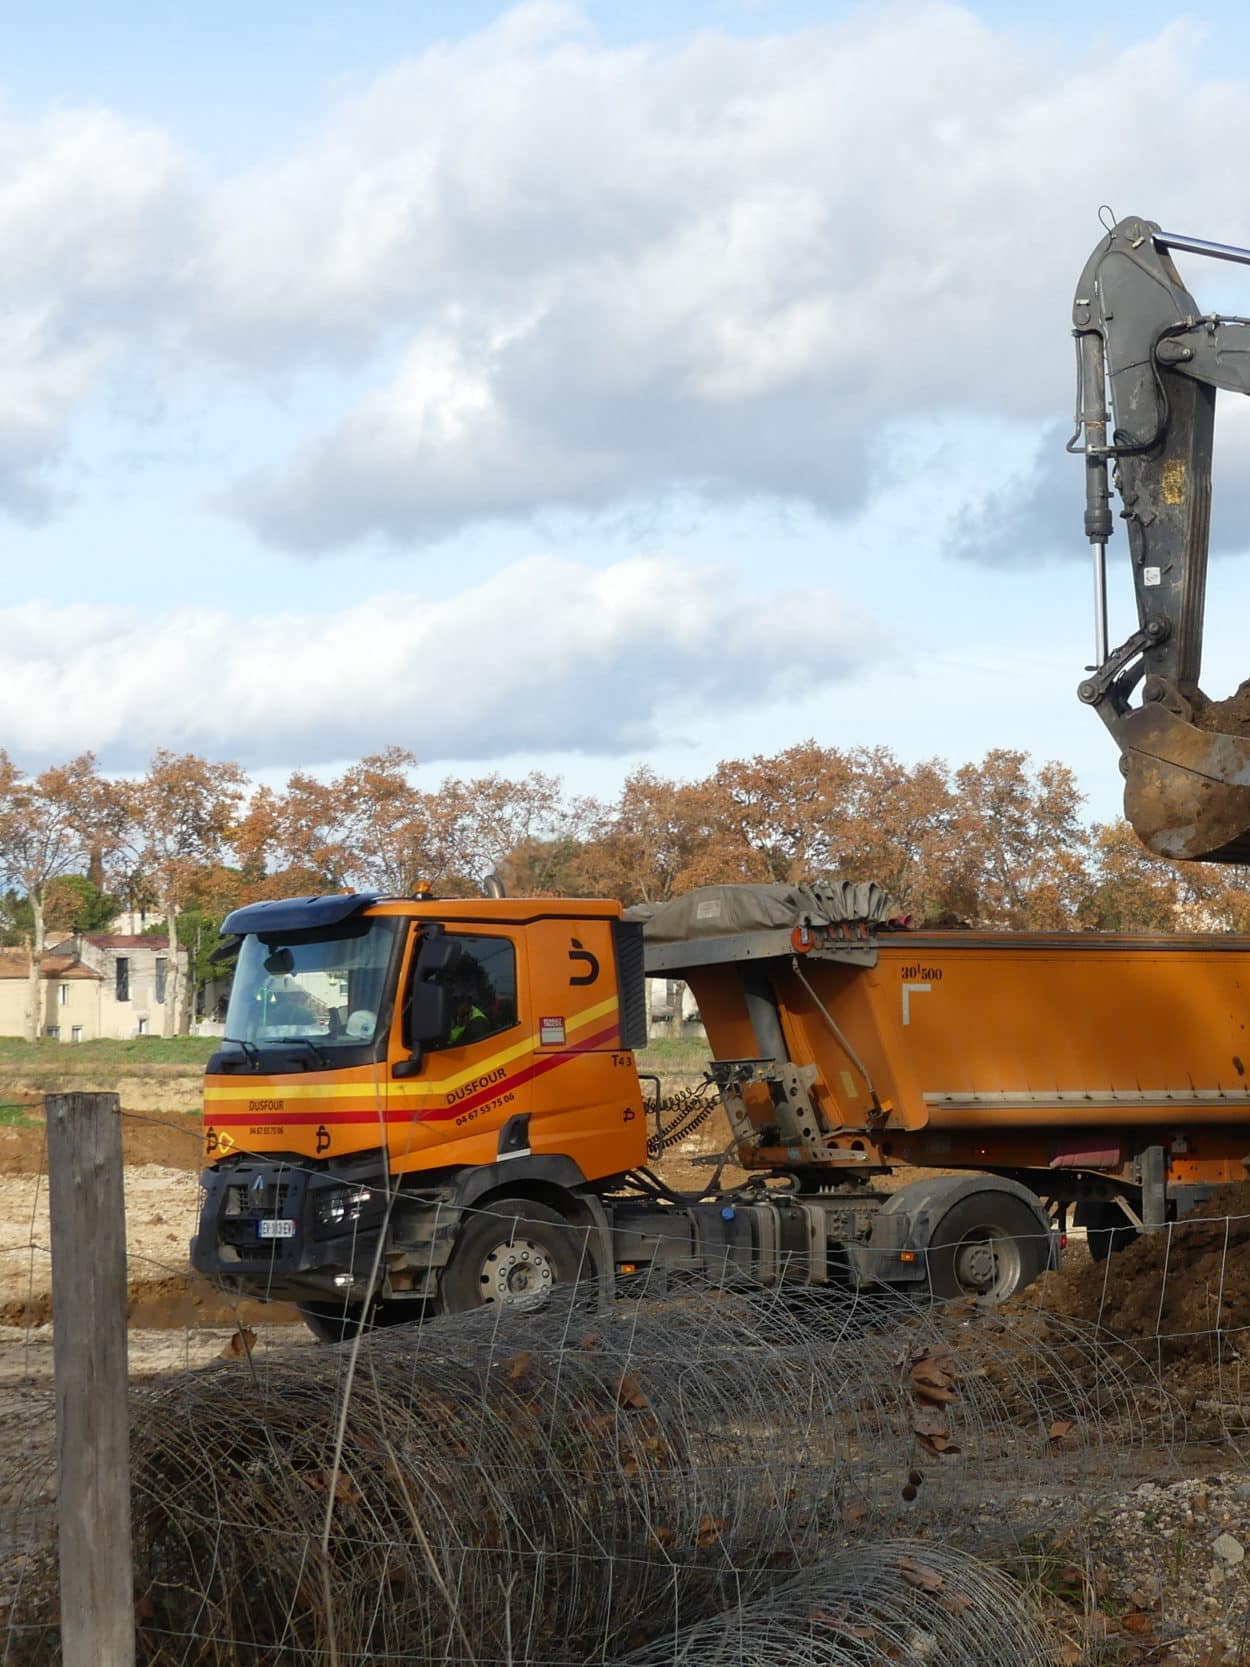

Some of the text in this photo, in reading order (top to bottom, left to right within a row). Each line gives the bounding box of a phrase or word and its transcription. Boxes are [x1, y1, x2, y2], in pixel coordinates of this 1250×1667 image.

[446, 1067, 507, 1105] DUSFOUR
[248, 1100, 284, 1111] DUSFOUR
[456, 1092, 515, 1126] 04 67 55 75 06
